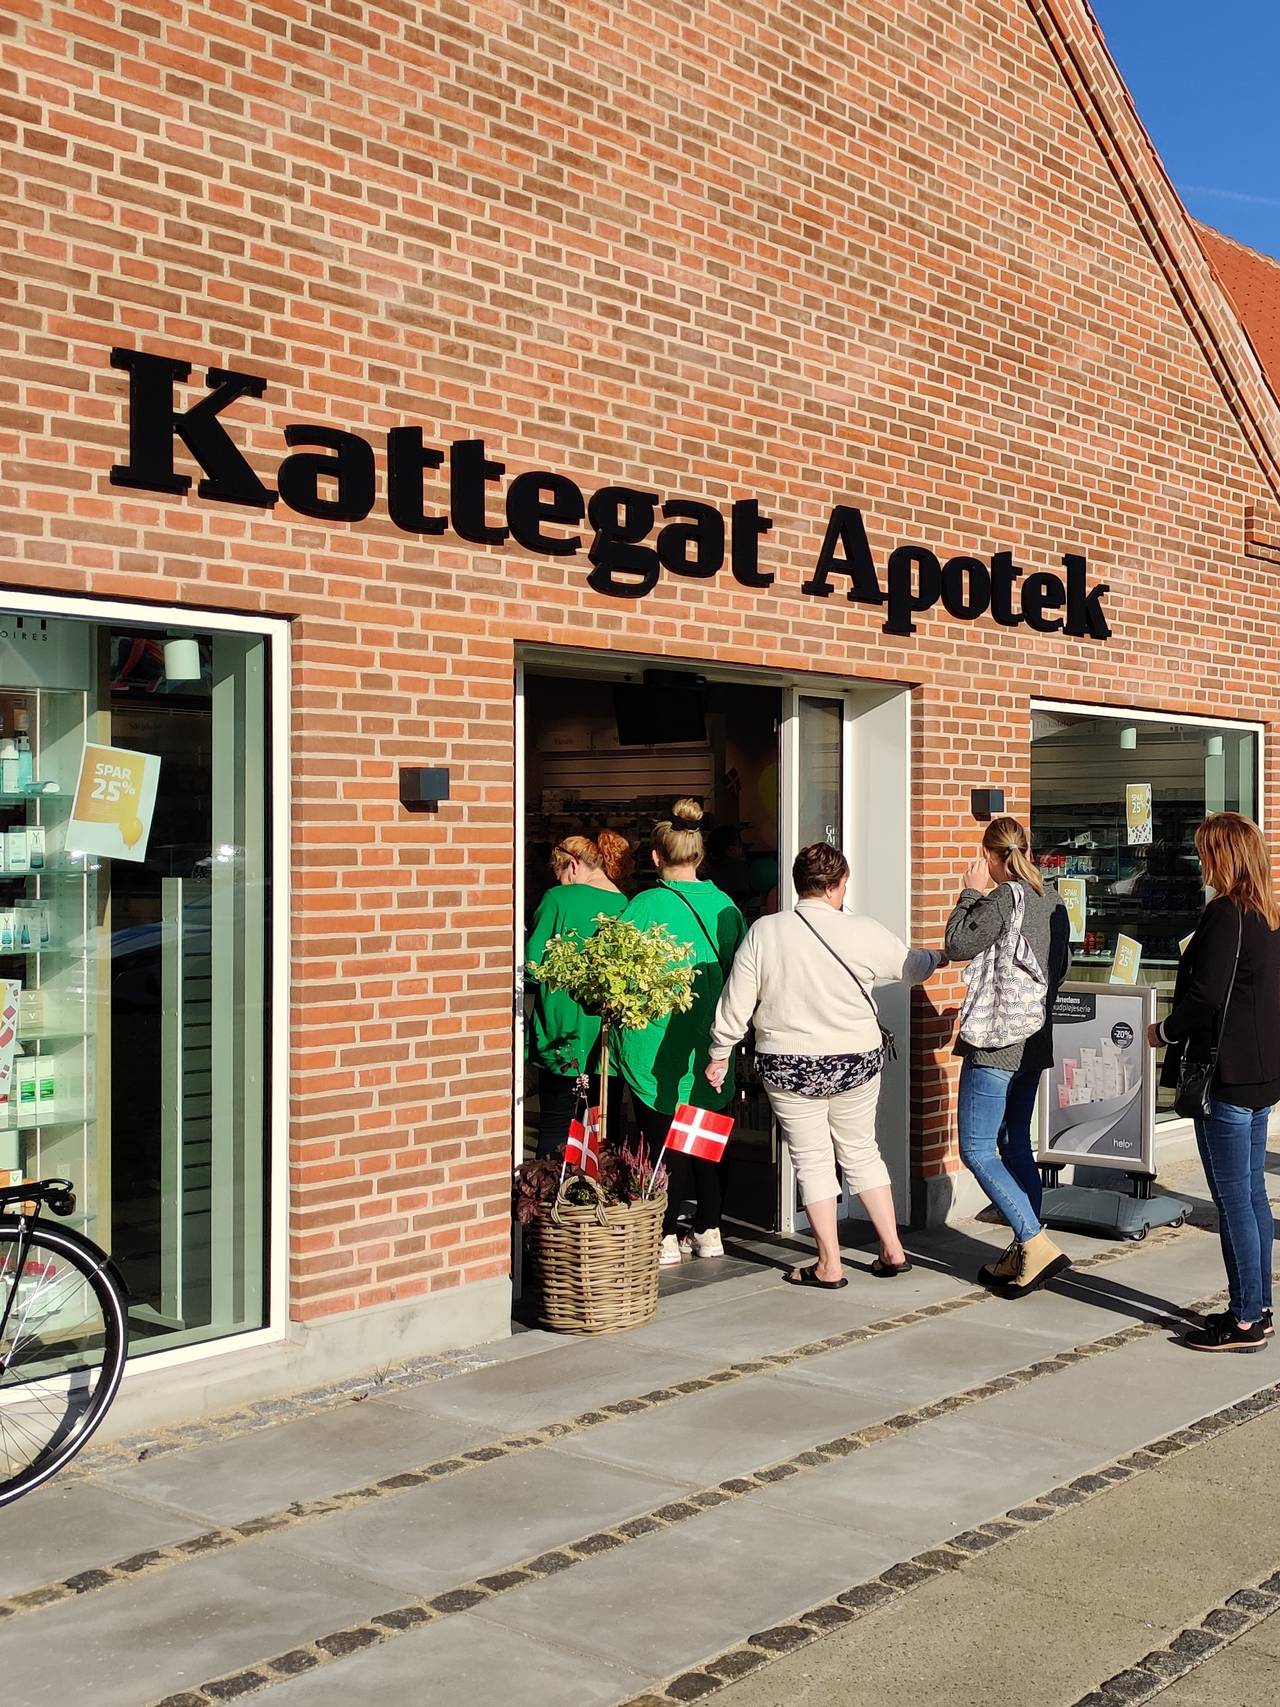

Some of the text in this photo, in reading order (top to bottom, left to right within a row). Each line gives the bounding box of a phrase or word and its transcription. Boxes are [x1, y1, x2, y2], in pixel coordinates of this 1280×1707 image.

[110, 347, 1113, 640] Kattegat Apotek
[95, 763, 132, 780] SPAR
[90, 777, 136, 802] 25%
[1055, 994, 1081, 1004] ånedens
[1113, 1030, 1133, 1039] -20%
